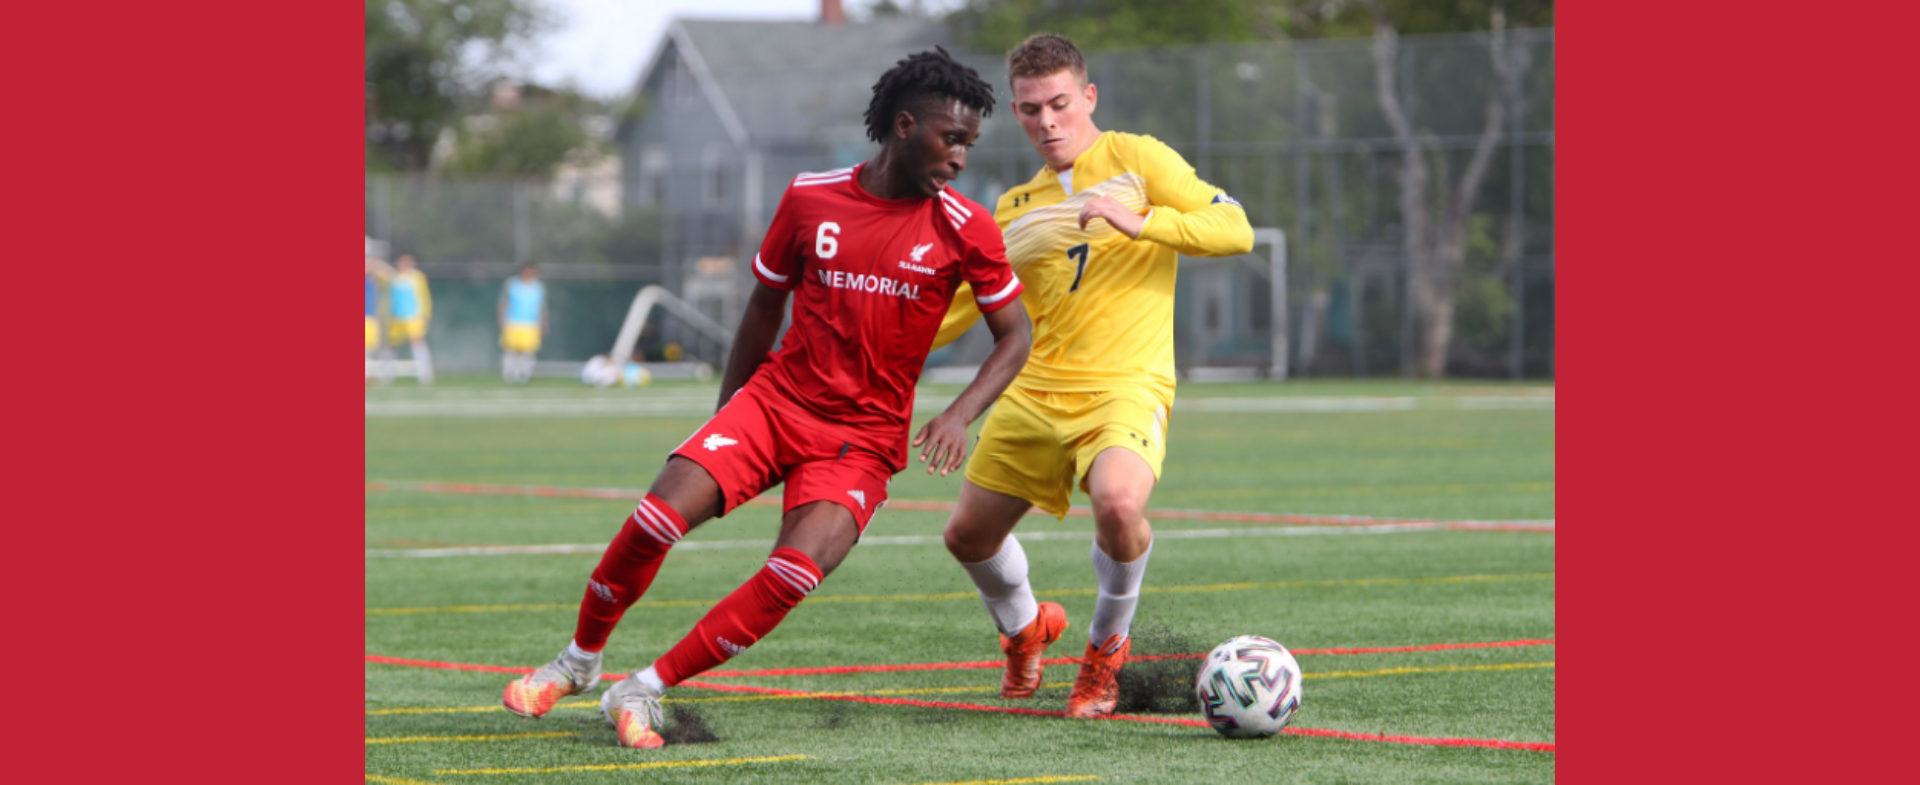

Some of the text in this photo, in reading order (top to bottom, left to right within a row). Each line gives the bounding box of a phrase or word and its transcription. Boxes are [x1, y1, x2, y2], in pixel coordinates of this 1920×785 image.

[815, 221, 841, 259] 6
[818, 269, 921, 300] MEMORIAL
[1067, 243, 1090, 294] 7
